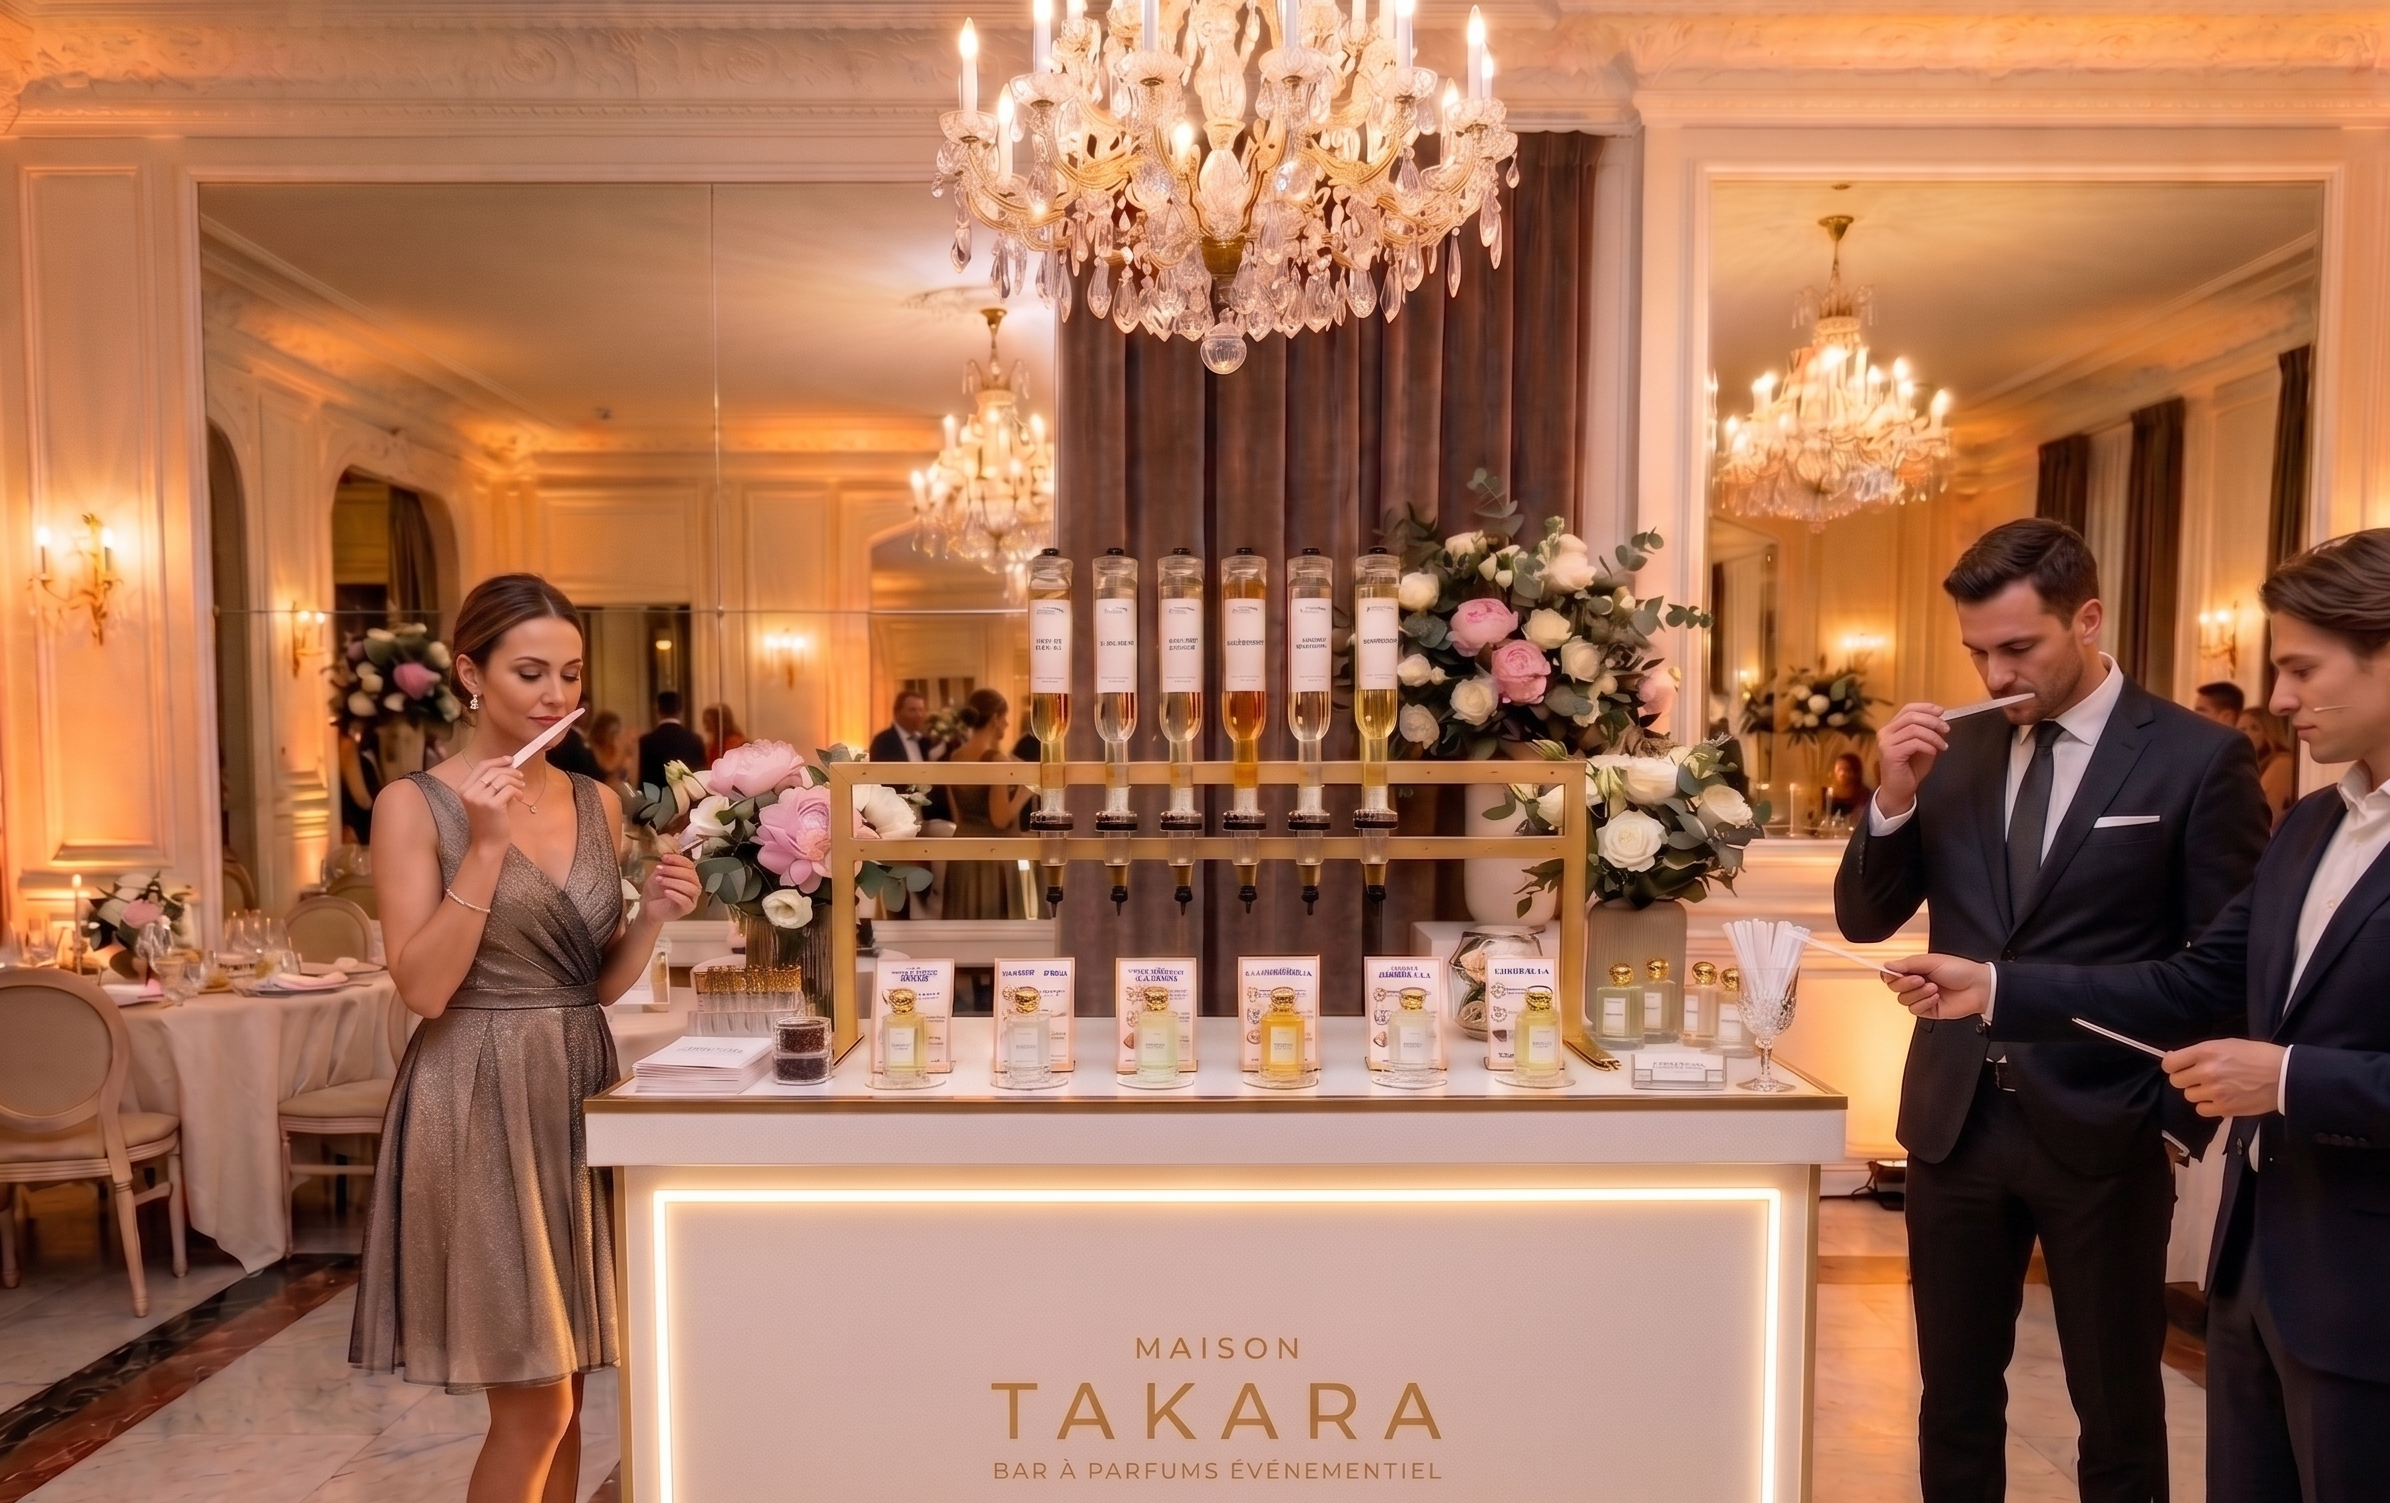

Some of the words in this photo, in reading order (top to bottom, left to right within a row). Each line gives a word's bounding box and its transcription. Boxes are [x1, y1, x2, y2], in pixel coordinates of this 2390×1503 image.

[1136, 1336, 1299, 1360] MAISON
[990, 1381, 1442, 1441] TAKARA
[993, 1462, 1047, 1480] BAR
[1059, 1458, 1077, 1480] À
[1088, 1462, 1219, 1480] PARFUMS
[1231, 1458, 1442, 1480] ÉVÉNEMENTIEL
